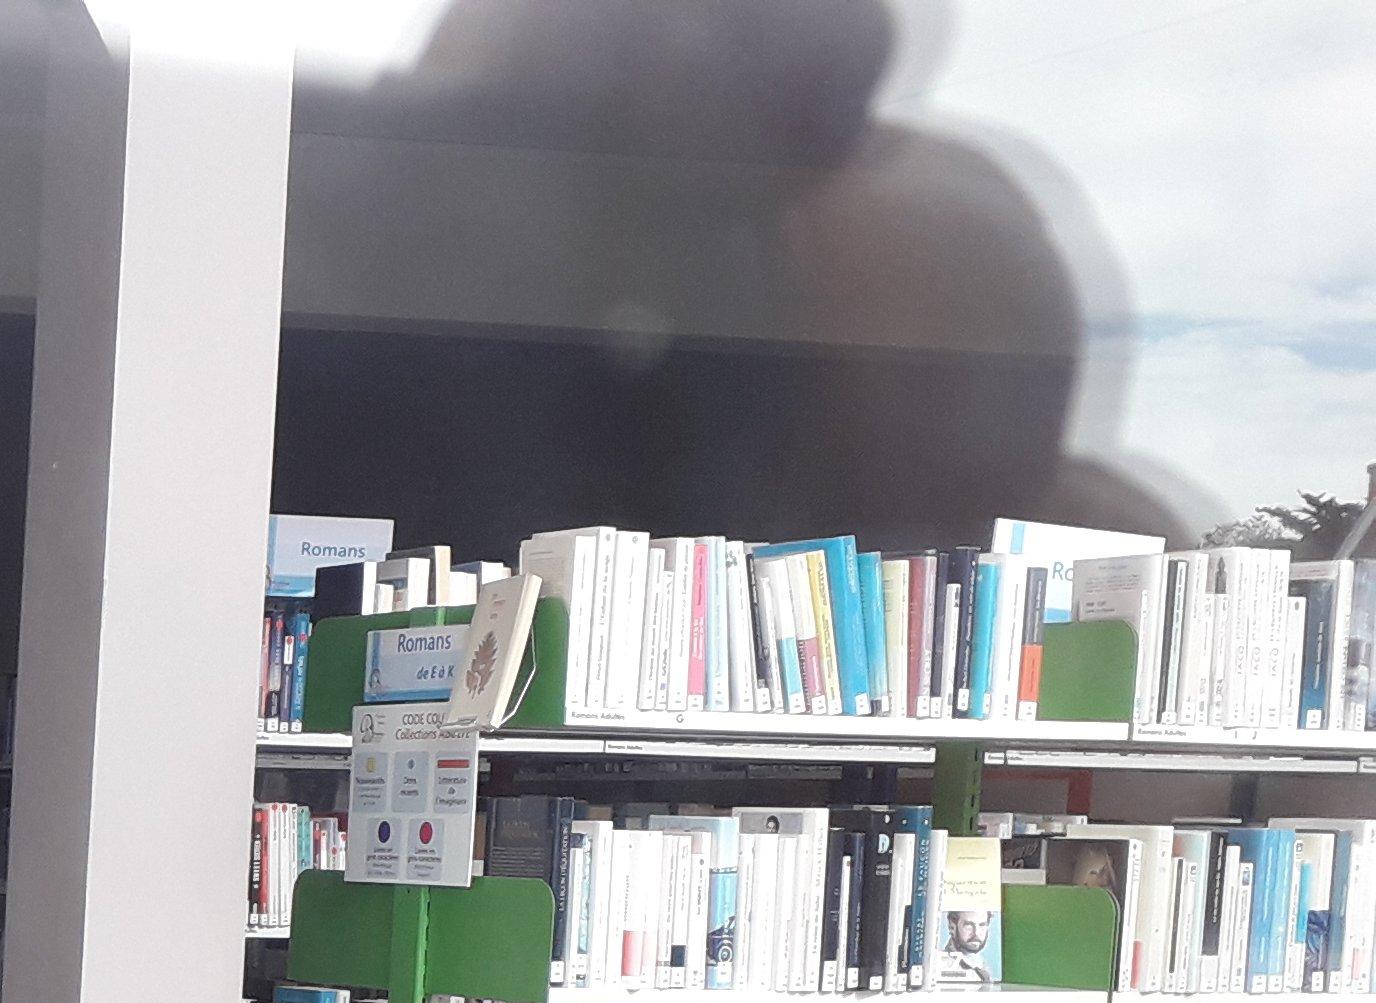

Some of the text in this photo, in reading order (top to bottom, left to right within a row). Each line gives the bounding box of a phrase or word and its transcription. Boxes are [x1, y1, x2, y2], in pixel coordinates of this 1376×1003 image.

[301, 541, 366, 558] Romans
[398, 633, 451, 652] Romans
[417, 666, 429, 680] de
